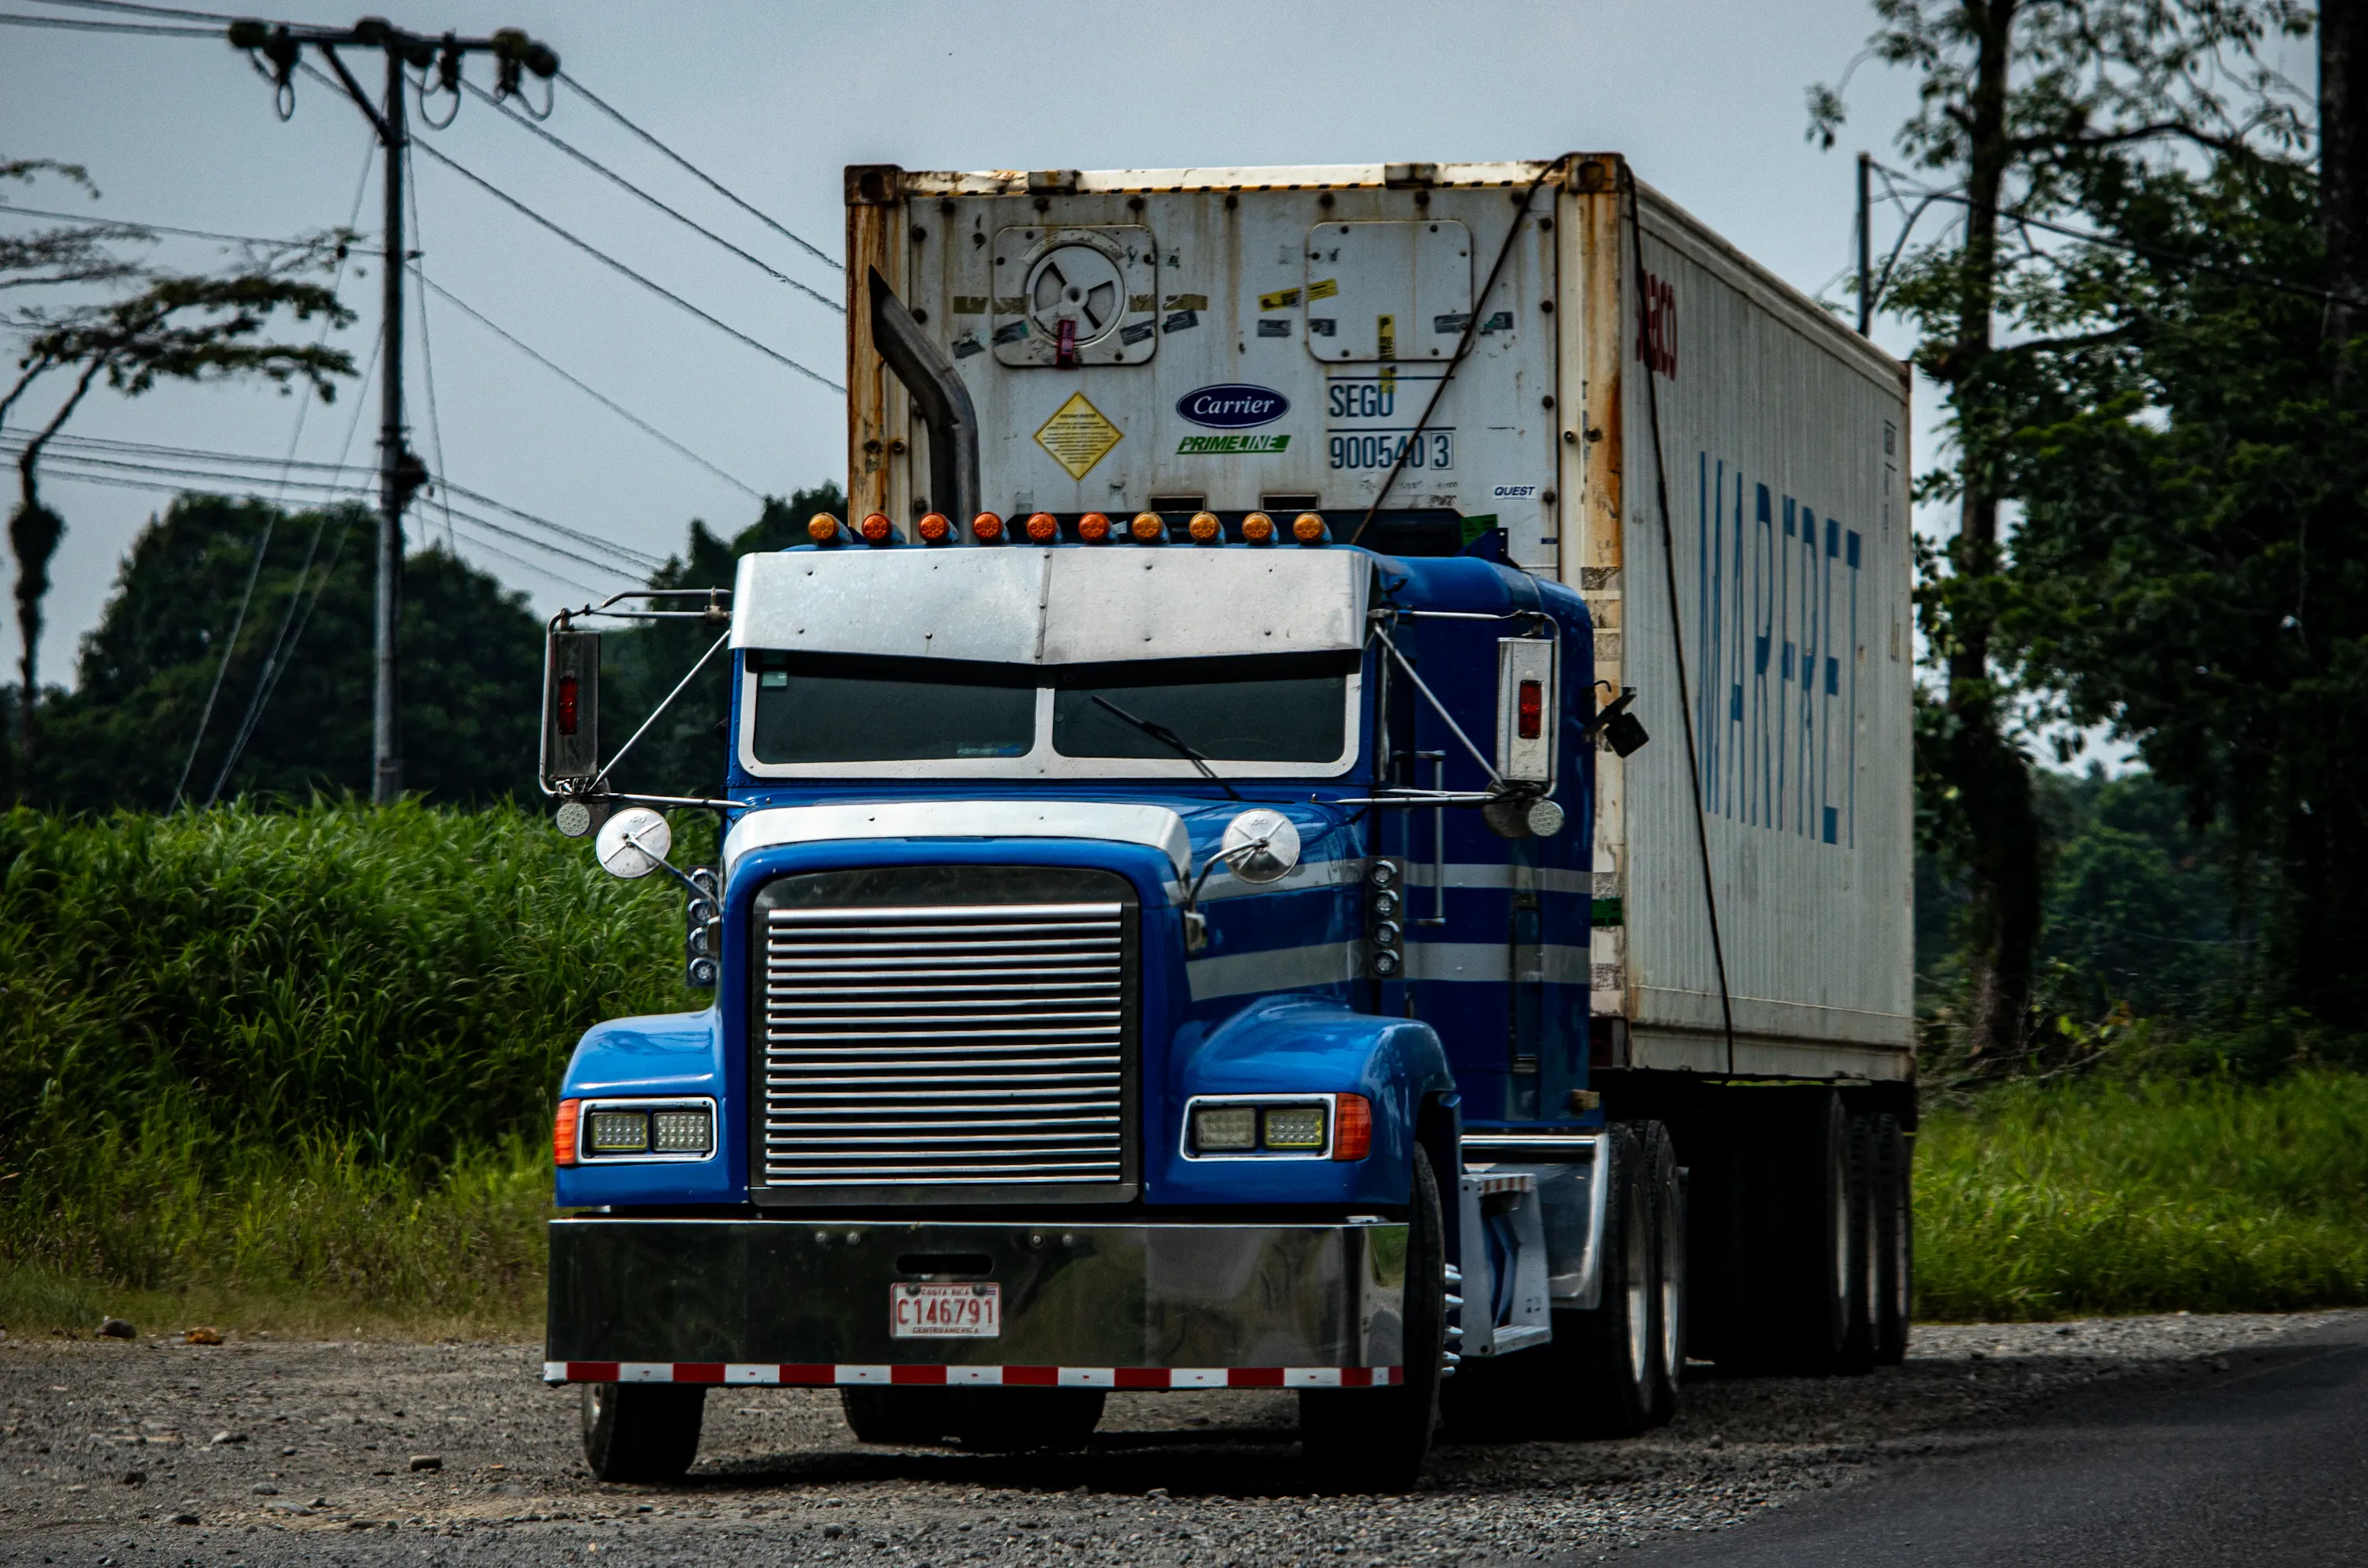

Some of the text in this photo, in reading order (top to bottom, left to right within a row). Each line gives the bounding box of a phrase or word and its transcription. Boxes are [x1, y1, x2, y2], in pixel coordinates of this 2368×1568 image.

[1193, 395, 1275, 414] Carrier
[1329, 384, 1394, 417] SEGU
[1178, 435, 1287, 451] PRIMELINE
[1330, 435, 1449, 470] 900540 3
[1494, 486, 1535, 496] QUEST
[1698, 451, 1862, 849] MARFRET
[921, 1288, 970, 1297] COSTA RICA
[897, 1297, 993, 1326] C146791
